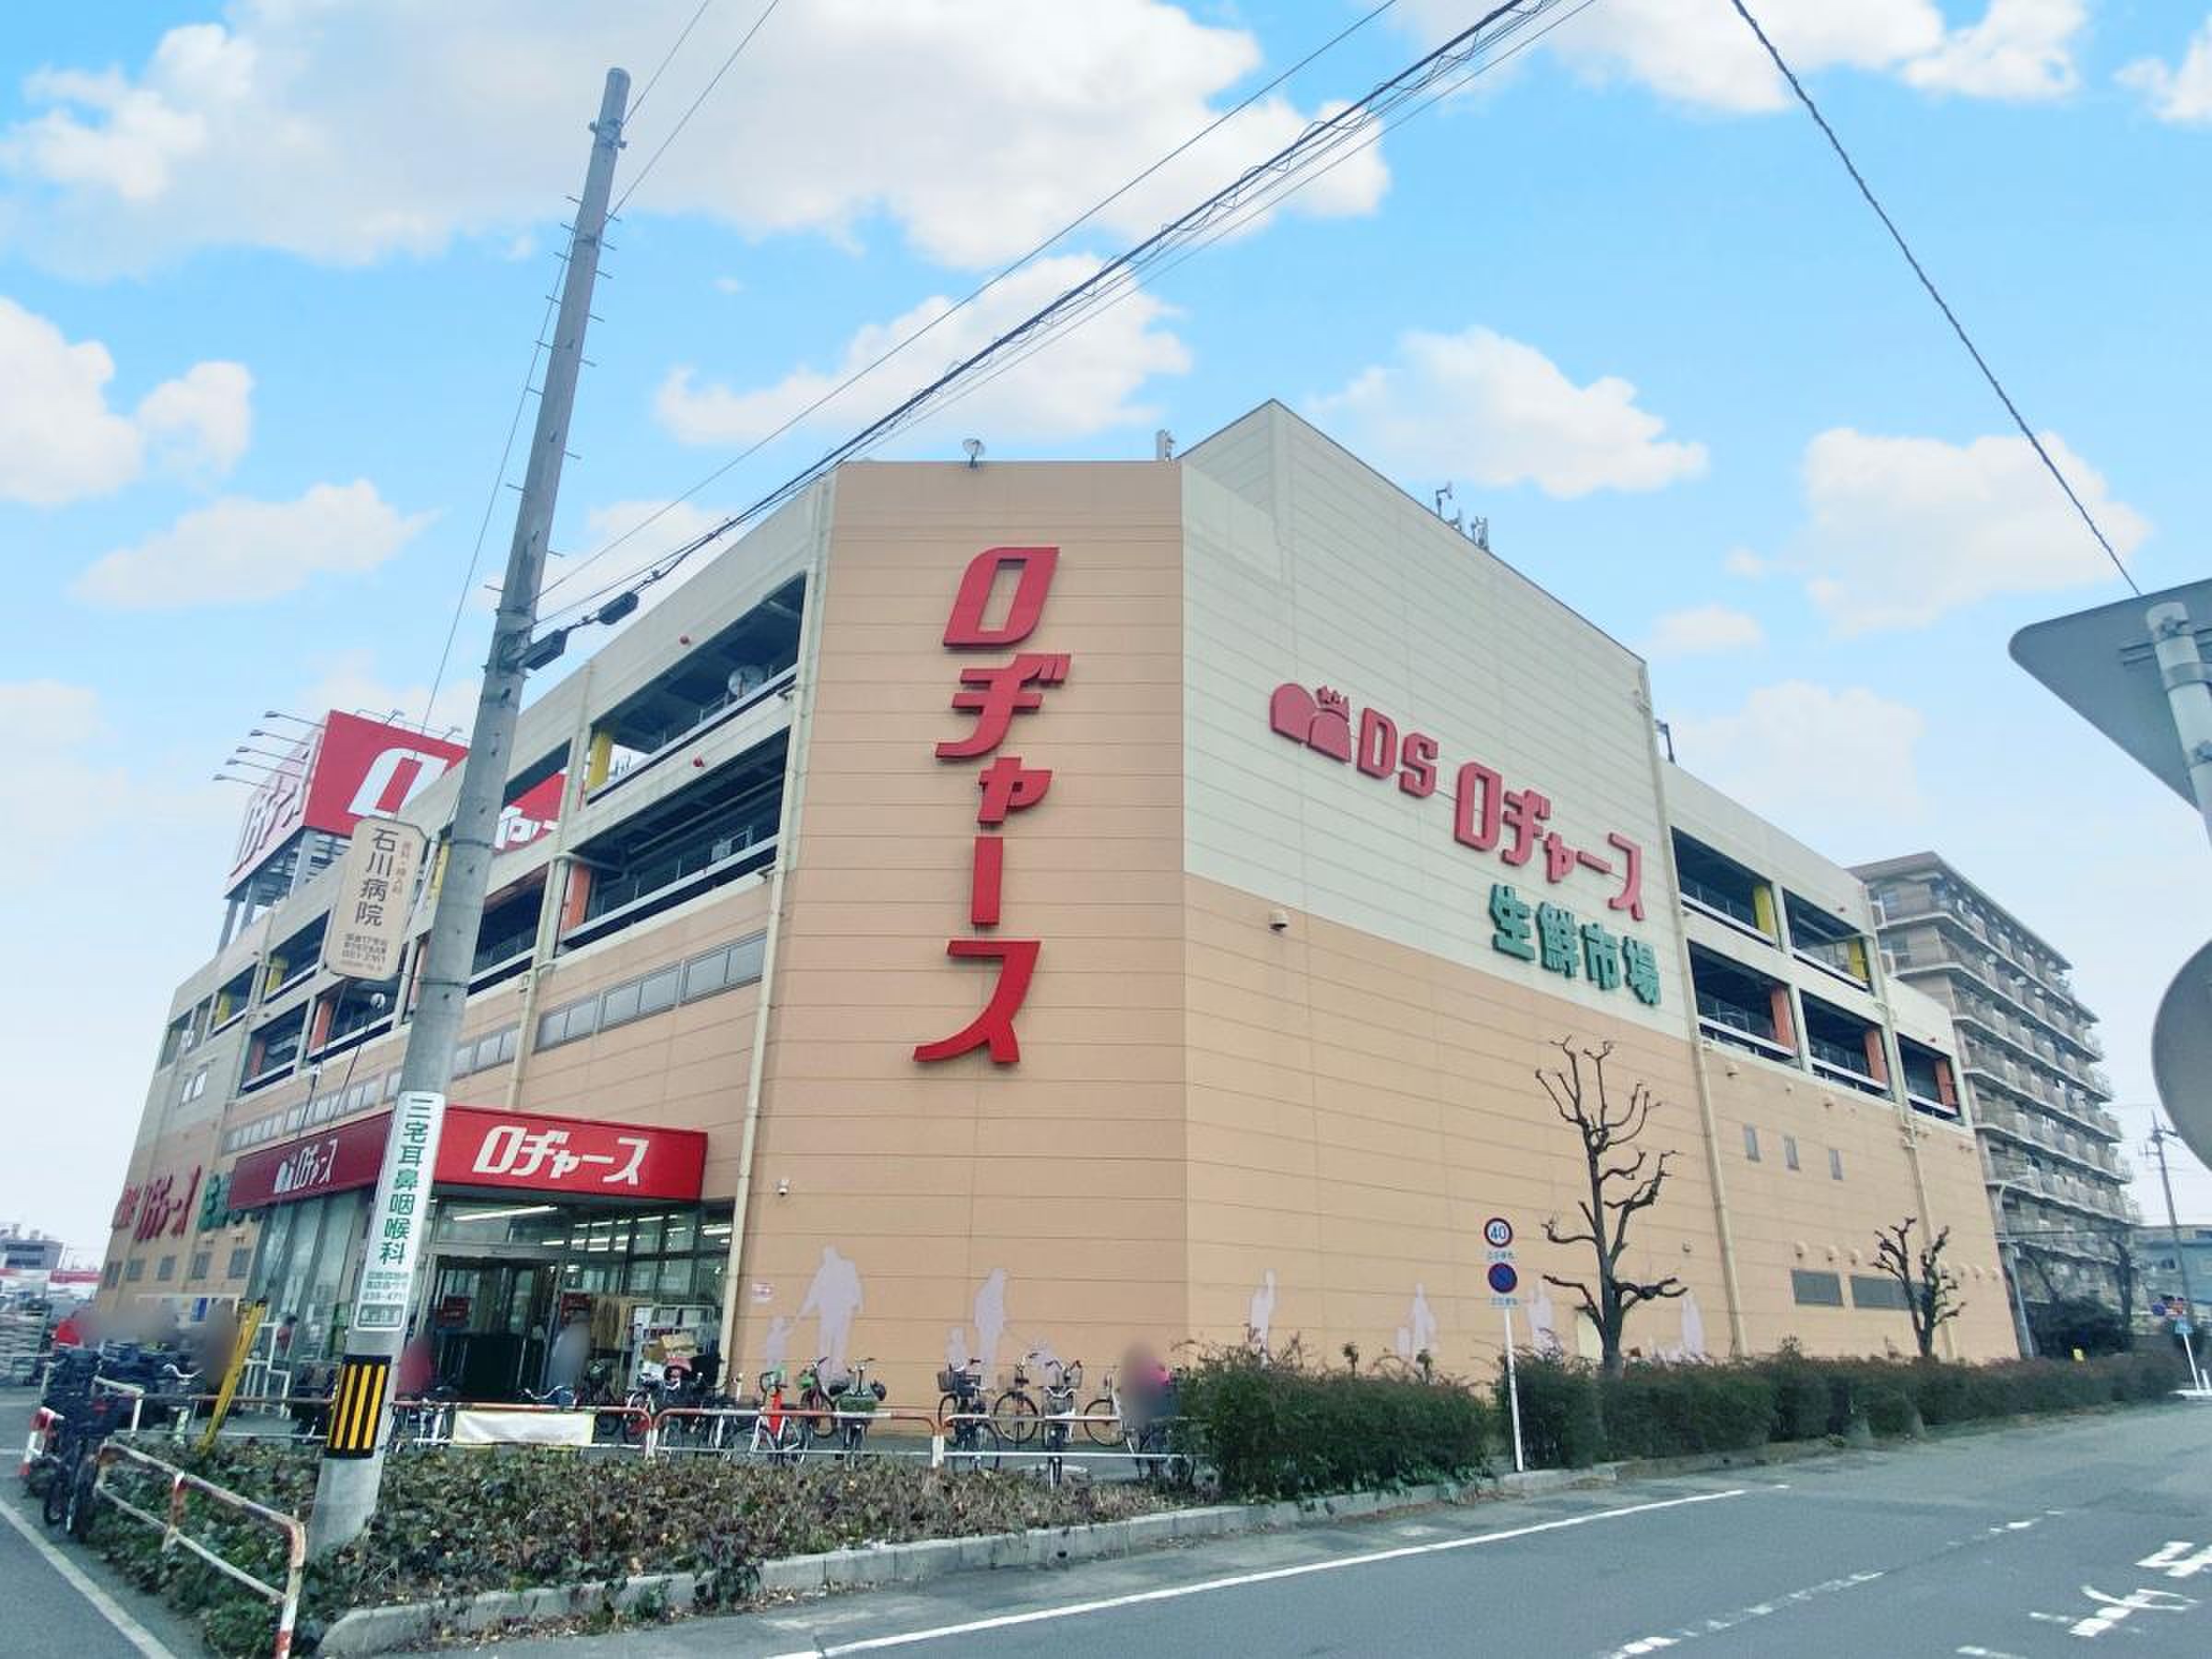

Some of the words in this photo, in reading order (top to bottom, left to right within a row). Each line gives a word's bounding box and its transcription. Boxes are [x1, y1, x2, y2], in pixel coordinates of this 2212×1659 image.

[912, 547, 1072, 1063] ロヂャース
[1356, 707, 1438, 798] DS
[1453, 761, 1645, 921] ロヂャース
[354, 828, 399, 927] 石川病院
[1489, 883, 1662, 1006] 生鮮市場
[379, 1098, 434, 1265] 三宅耳鼻咽喉科
[471, 1124, 650, 1186] ロヂャース
[1489, 1225, 1507, 1240] 40
